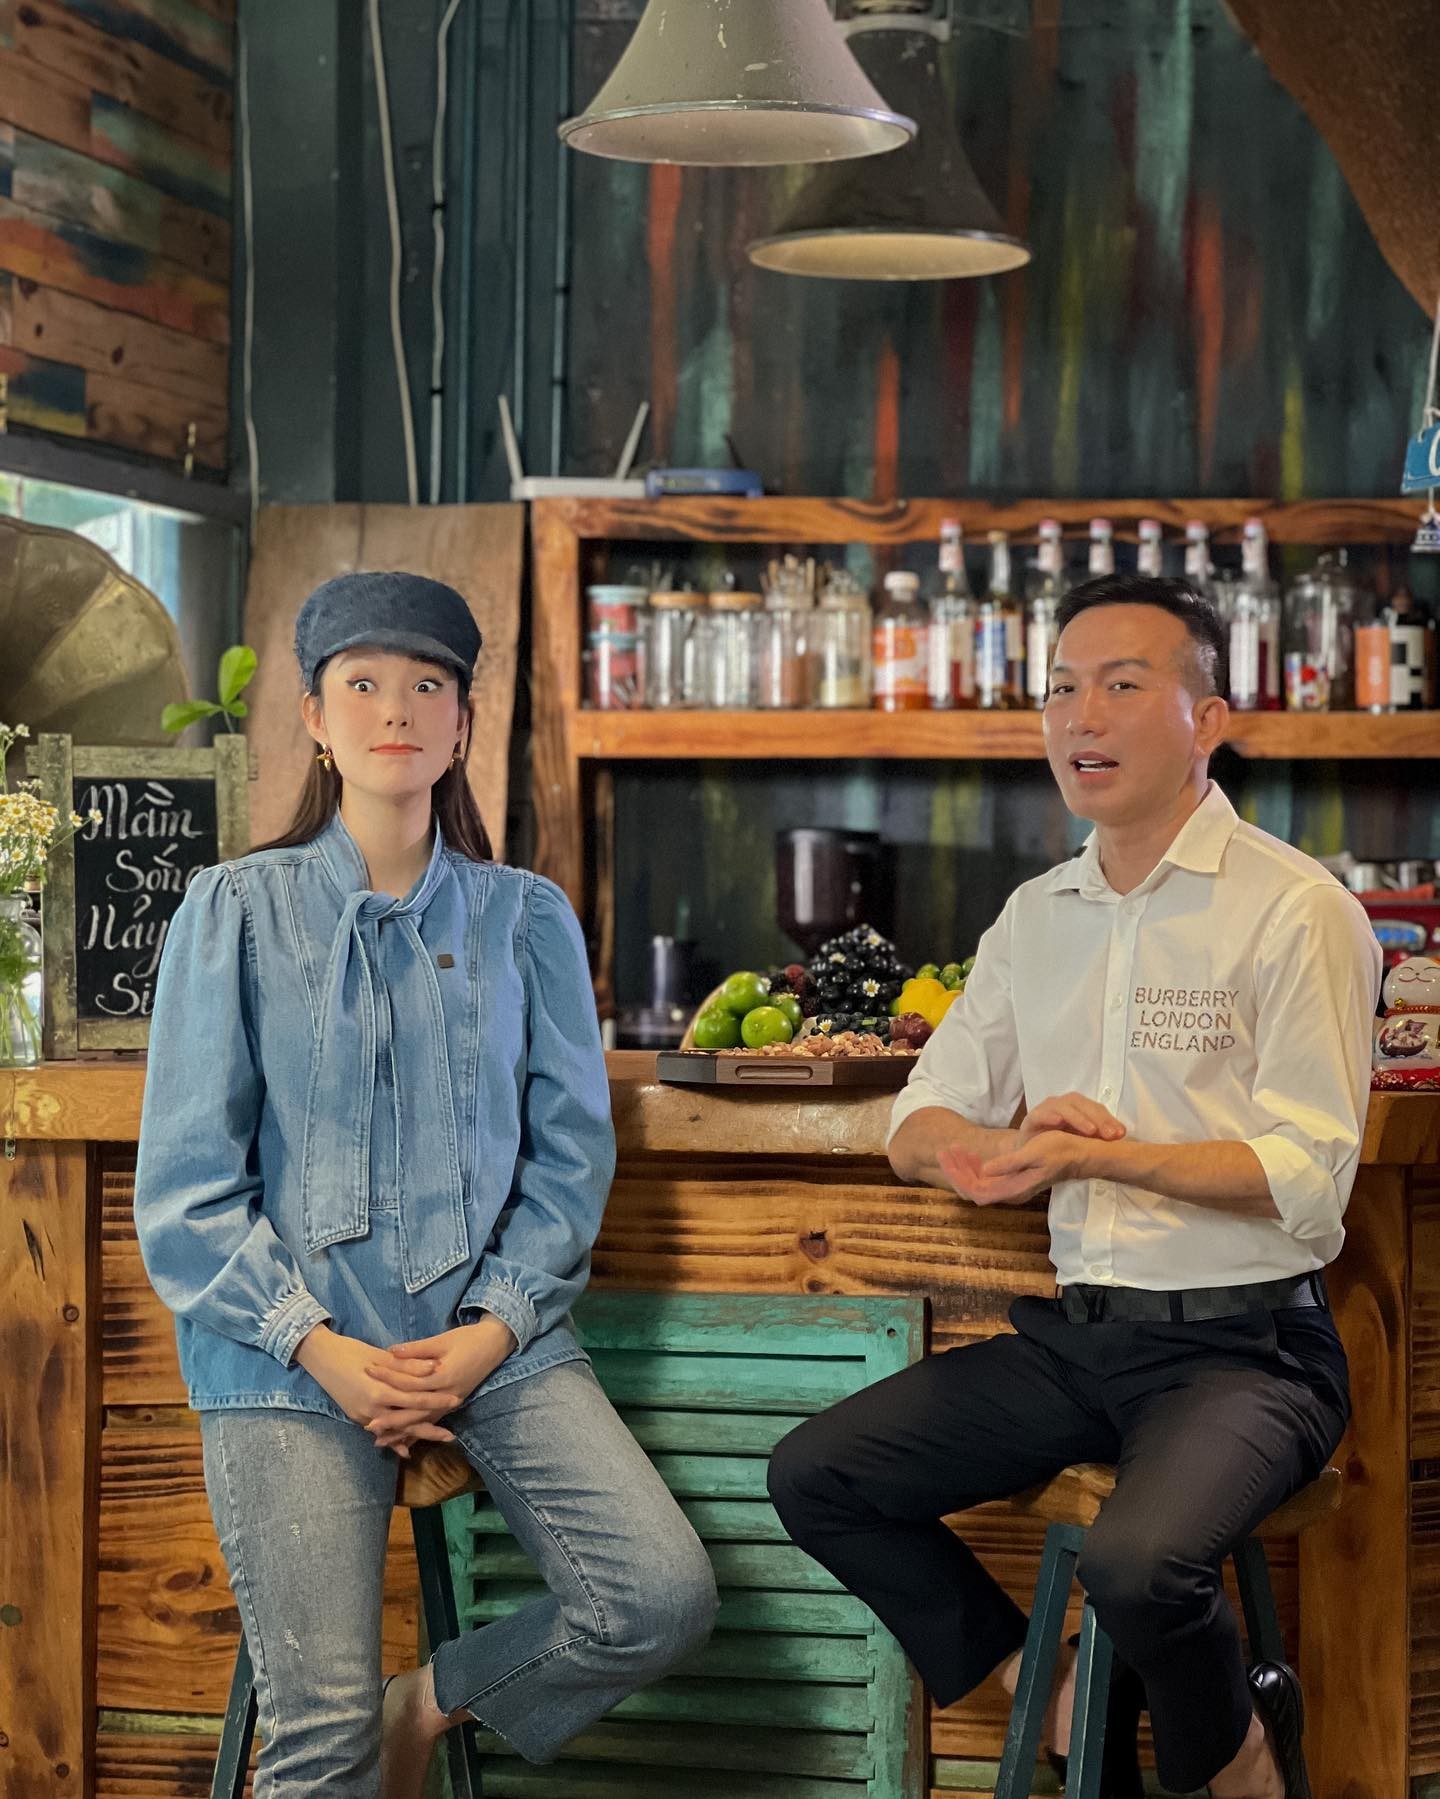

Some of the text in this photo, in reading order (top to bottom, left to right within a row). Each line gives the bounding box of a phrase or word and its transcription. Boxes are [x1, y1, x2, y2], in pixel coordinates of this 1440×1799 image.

[80, 781, 203, 840] Mầm
[95, 972, 154, 1015] Si
[1134, 987, 1239, 1008] BURBERRY
[1140, 1010, 1231, 1030] LONDON
[1131, 1031, 1236, 1053] ENGLAND
